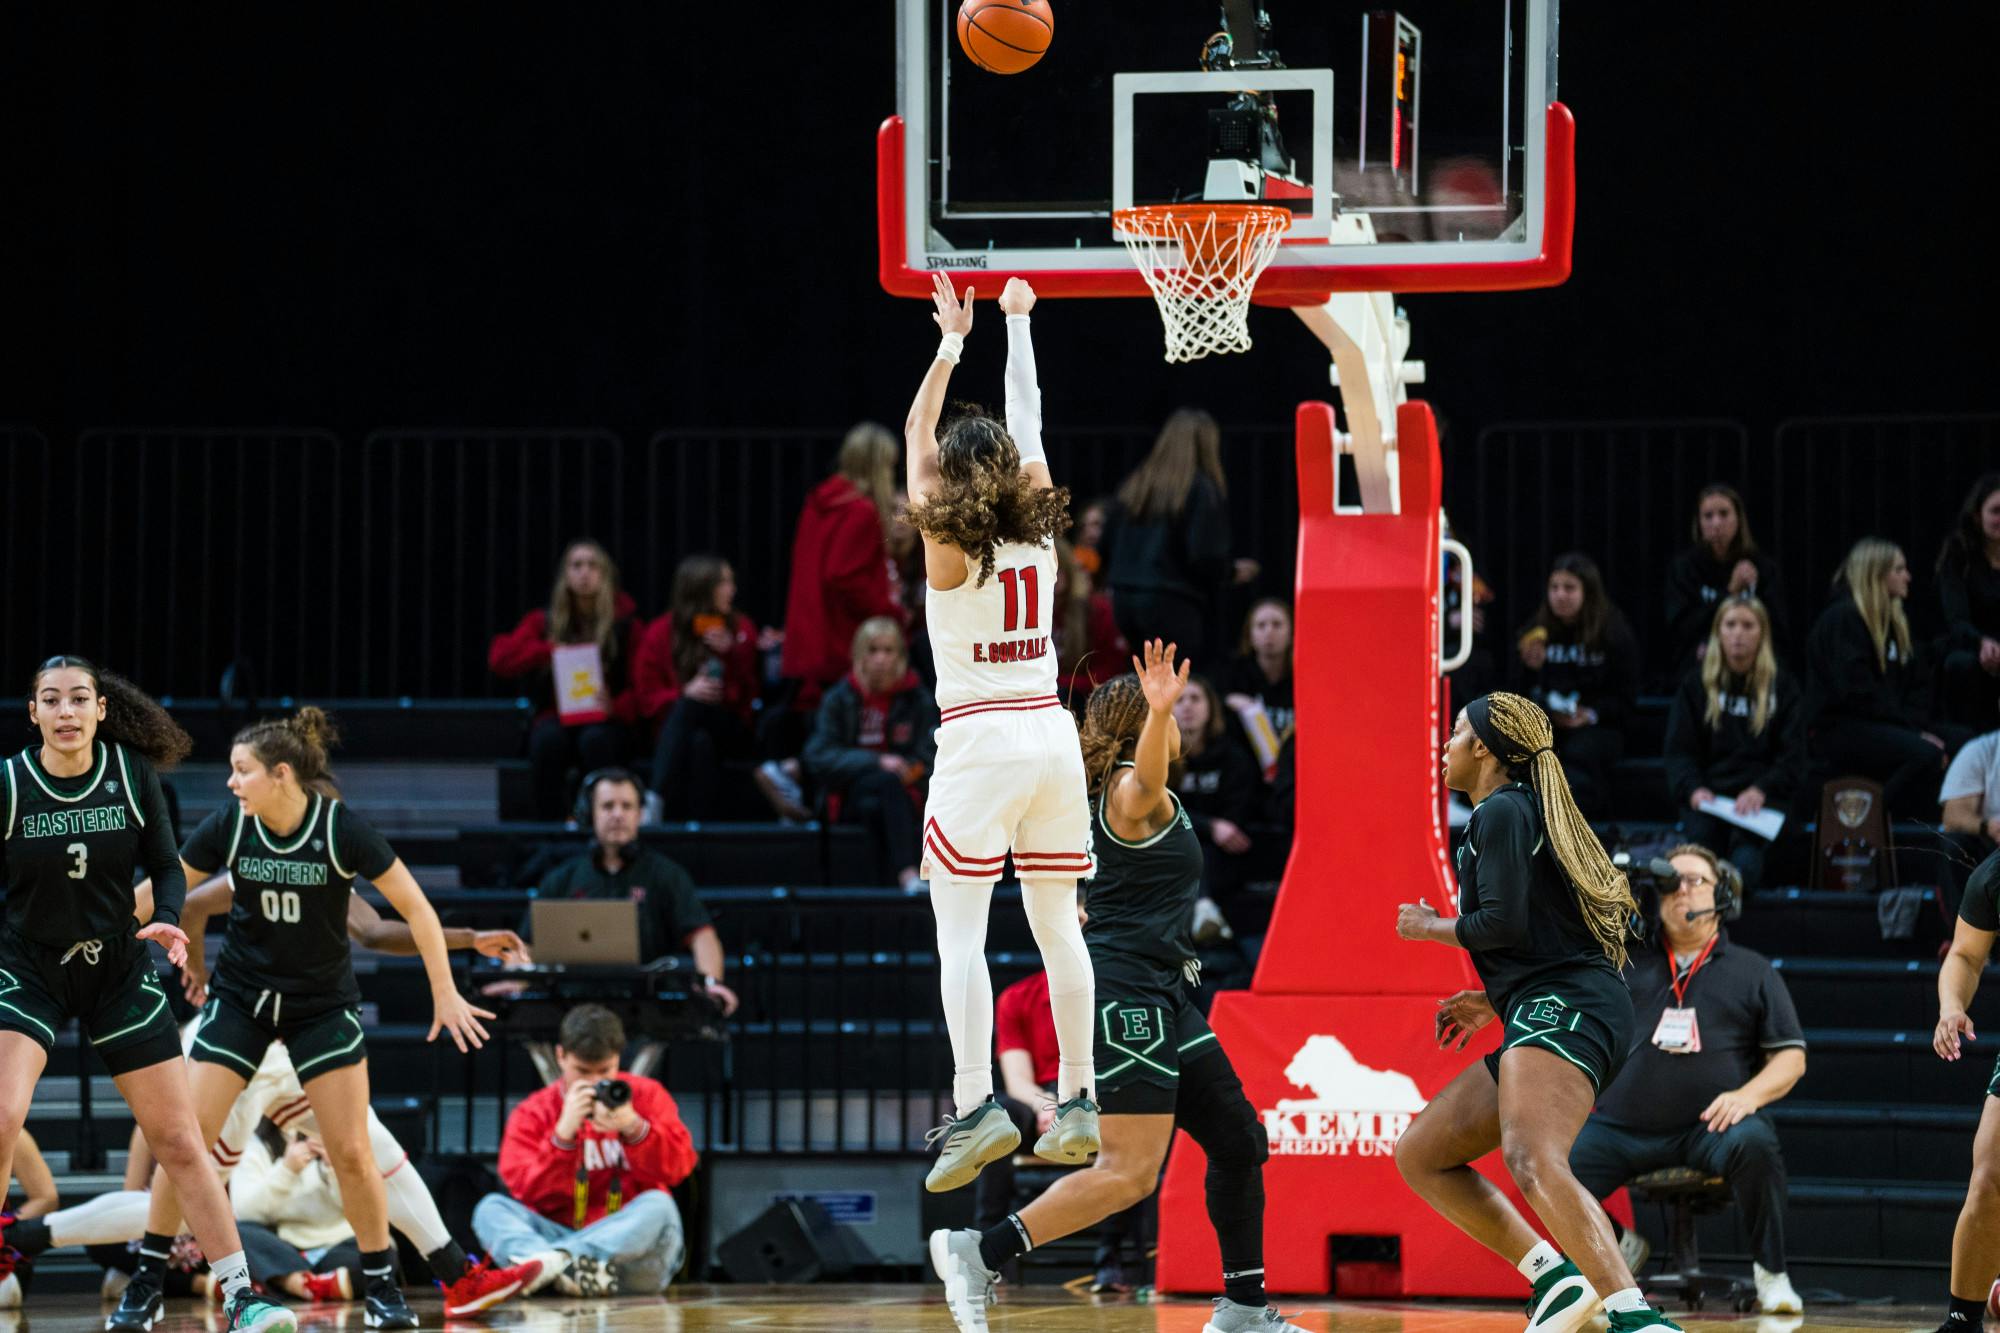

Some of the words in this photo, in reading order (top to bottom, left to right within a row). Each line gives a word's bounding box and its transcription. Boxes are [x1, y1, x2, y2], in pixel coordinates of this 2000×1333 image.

[926, 255, 987, 269] SPALDING
[998, 565, 1038, 632] 11
[22, 805, 126, 838] EASTERN
[67, 842, 88, 879] 3
[238, 856, 328, 885] EASTERN
[261, 889, 300, 923] 00
[1119, 1008, 1151, 1040] E
[1267, 1138, 1351, 1156] CREDIT
[1356, 1138, 1397, 1157] UN
